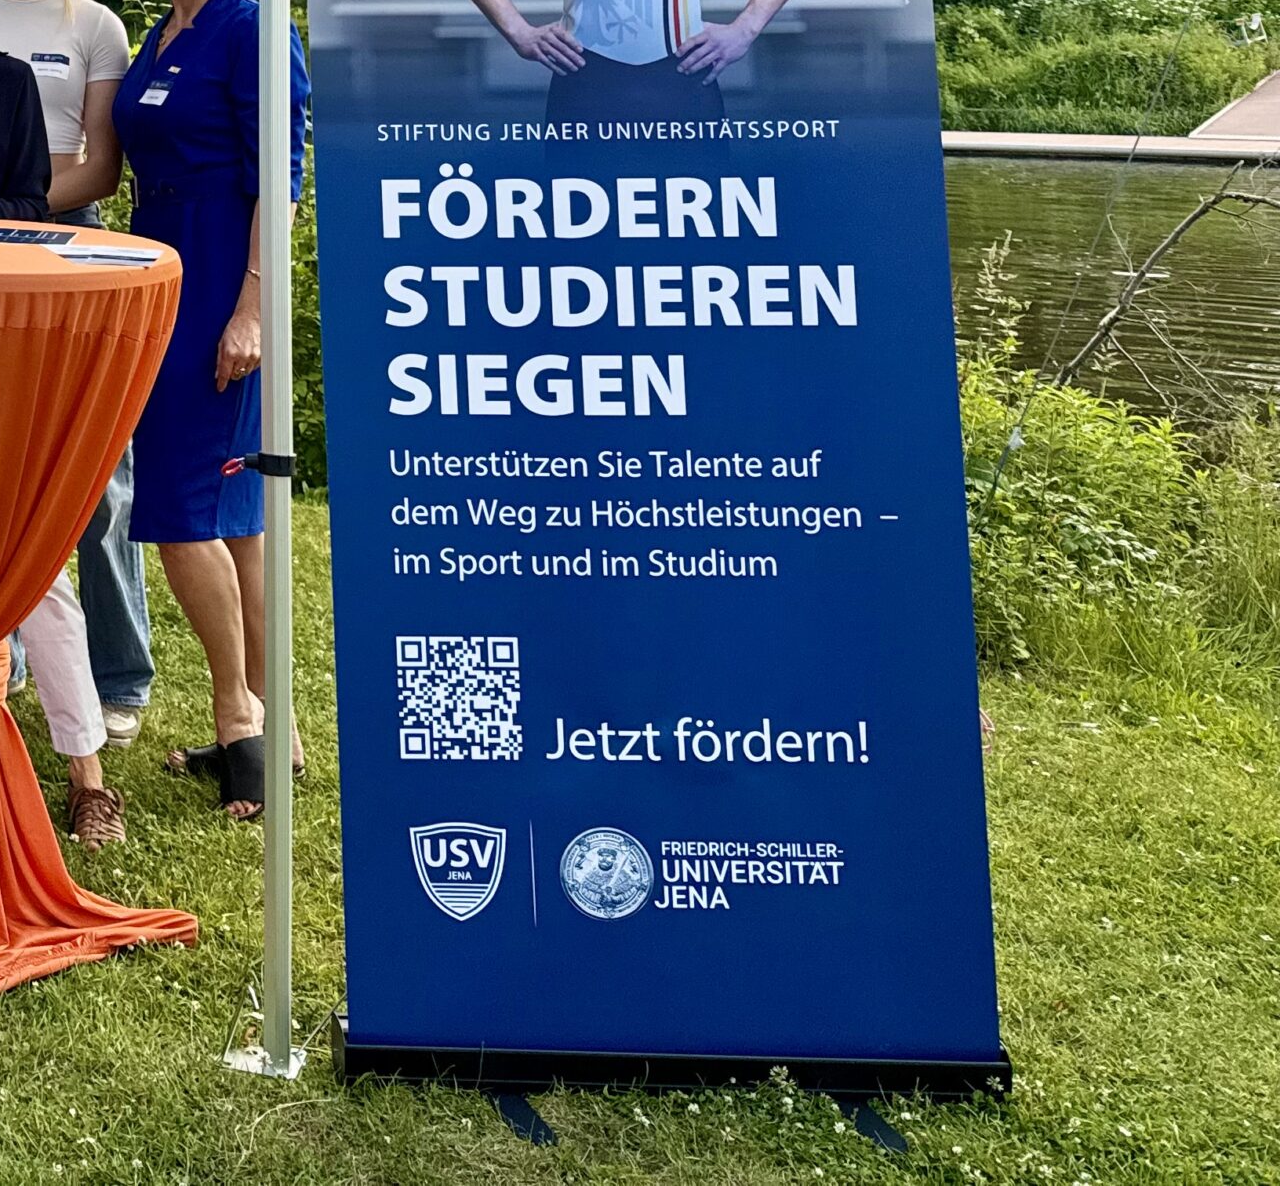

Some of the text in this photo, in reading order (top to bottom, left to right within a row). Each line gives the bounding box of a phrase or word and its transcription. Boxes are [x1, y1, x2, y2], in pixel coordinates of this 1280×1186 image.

[377, 118, 840, 142] STIFTUNG JENAER UNIVERSITÄTSSPORT
[380, 162, 778, 240] FÖRDERN
[383, 264, 858, 328] STUDIEREN
[387, 353, 687, 417] SIEGEN
[389, 449, 823, 478] Unterstützen Sie Talente auf
[391, 497, 458, 526] dem
[466, 498, 537, 534] Weg
[545, 506, 581, 527] zu
[591, 498, 862, 535] Höchstleistungen
[393, 547, 778, 582] im Sport und im Studium
[546, 716, 869, 764] Jetzt fördern!
[422, 838, 496, 869] USV
[661, 841, 844, 858] FRIEDRICH-SCHILLER-
[447, 870, 473, 881] JENA
[662, 859, 845, 885] UNIVERSITÄT
[654, 885, 730, 910] JENA
